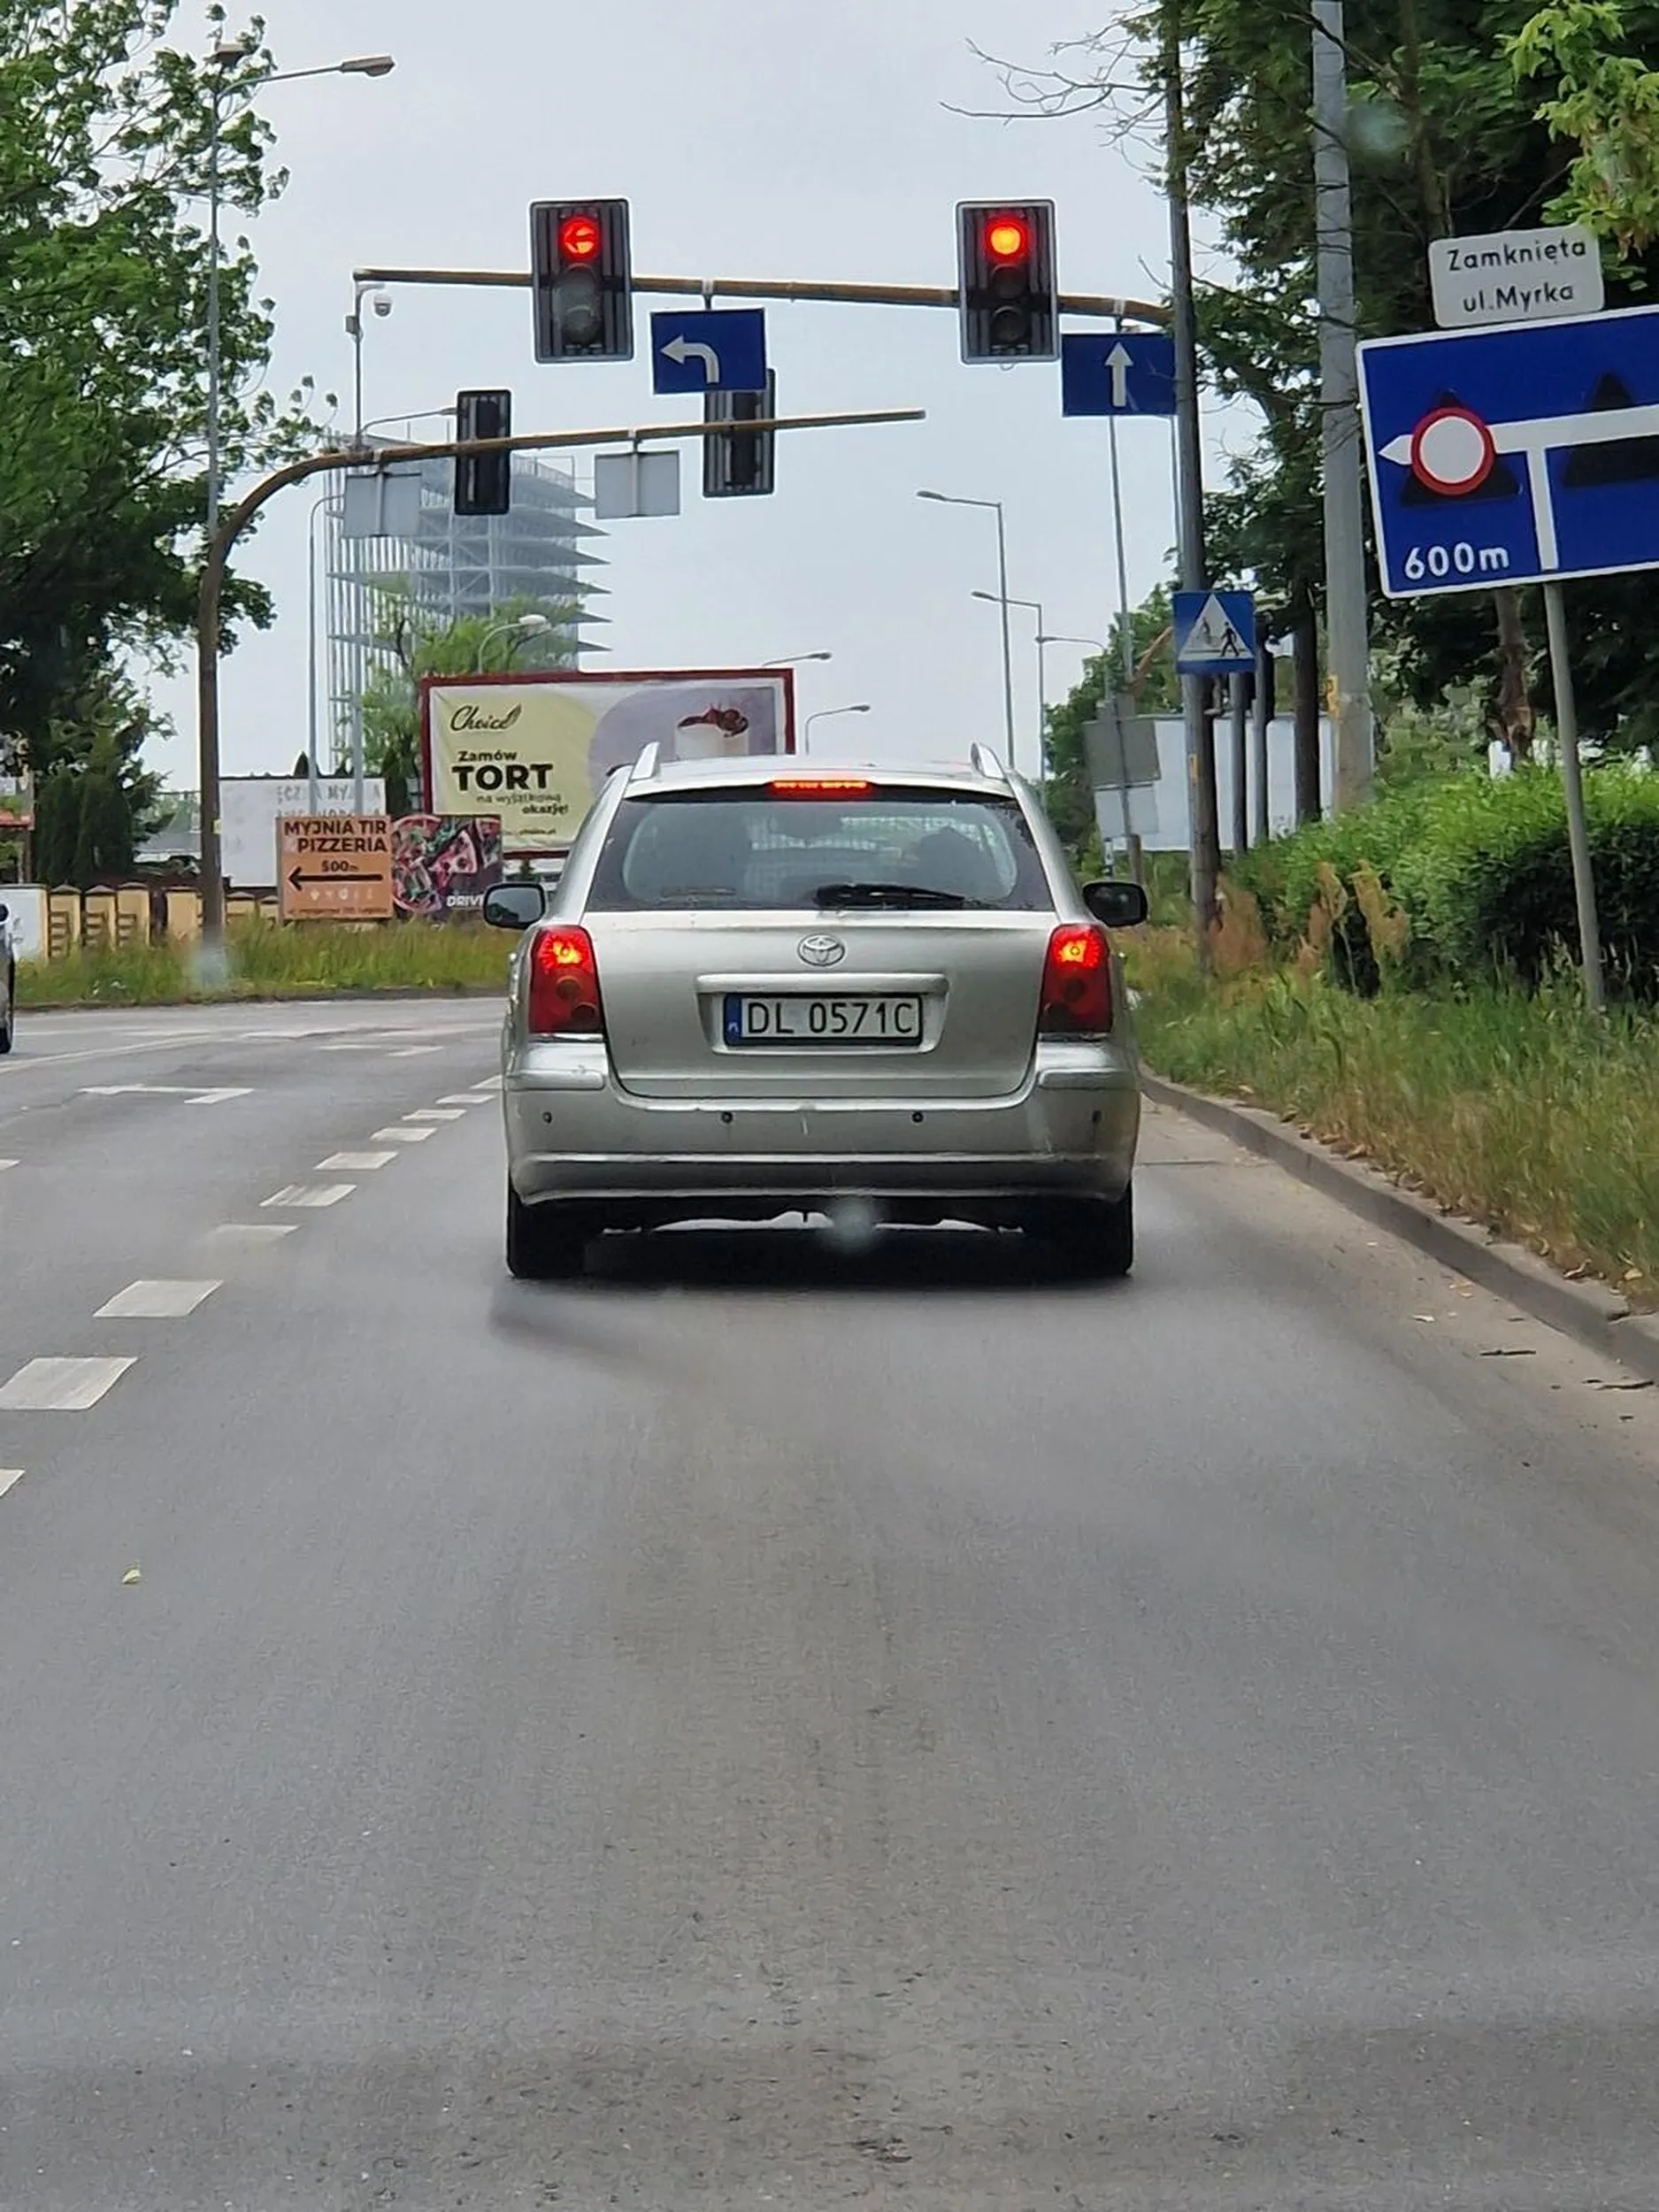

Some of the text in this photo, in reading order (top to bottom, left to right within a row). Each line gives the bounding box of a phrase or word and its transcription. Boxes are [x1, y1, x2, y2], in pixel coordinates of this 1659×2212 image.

[1447, 237, 1586, 272] Zamknięta
[1404, 541, 1509, 580] 600m
[449, 703, 521, 732] Choice
[457, 750, 518, 763] Zamów
[451, 763, 554, 791] TORT
[284, 819, 388, 836] MYJNIA TIR
[296, 837, 388, 853] PIZZERIA
[747, 1002, 795, 1034] DL
[808, 1002, 913, 1034] 0571C
